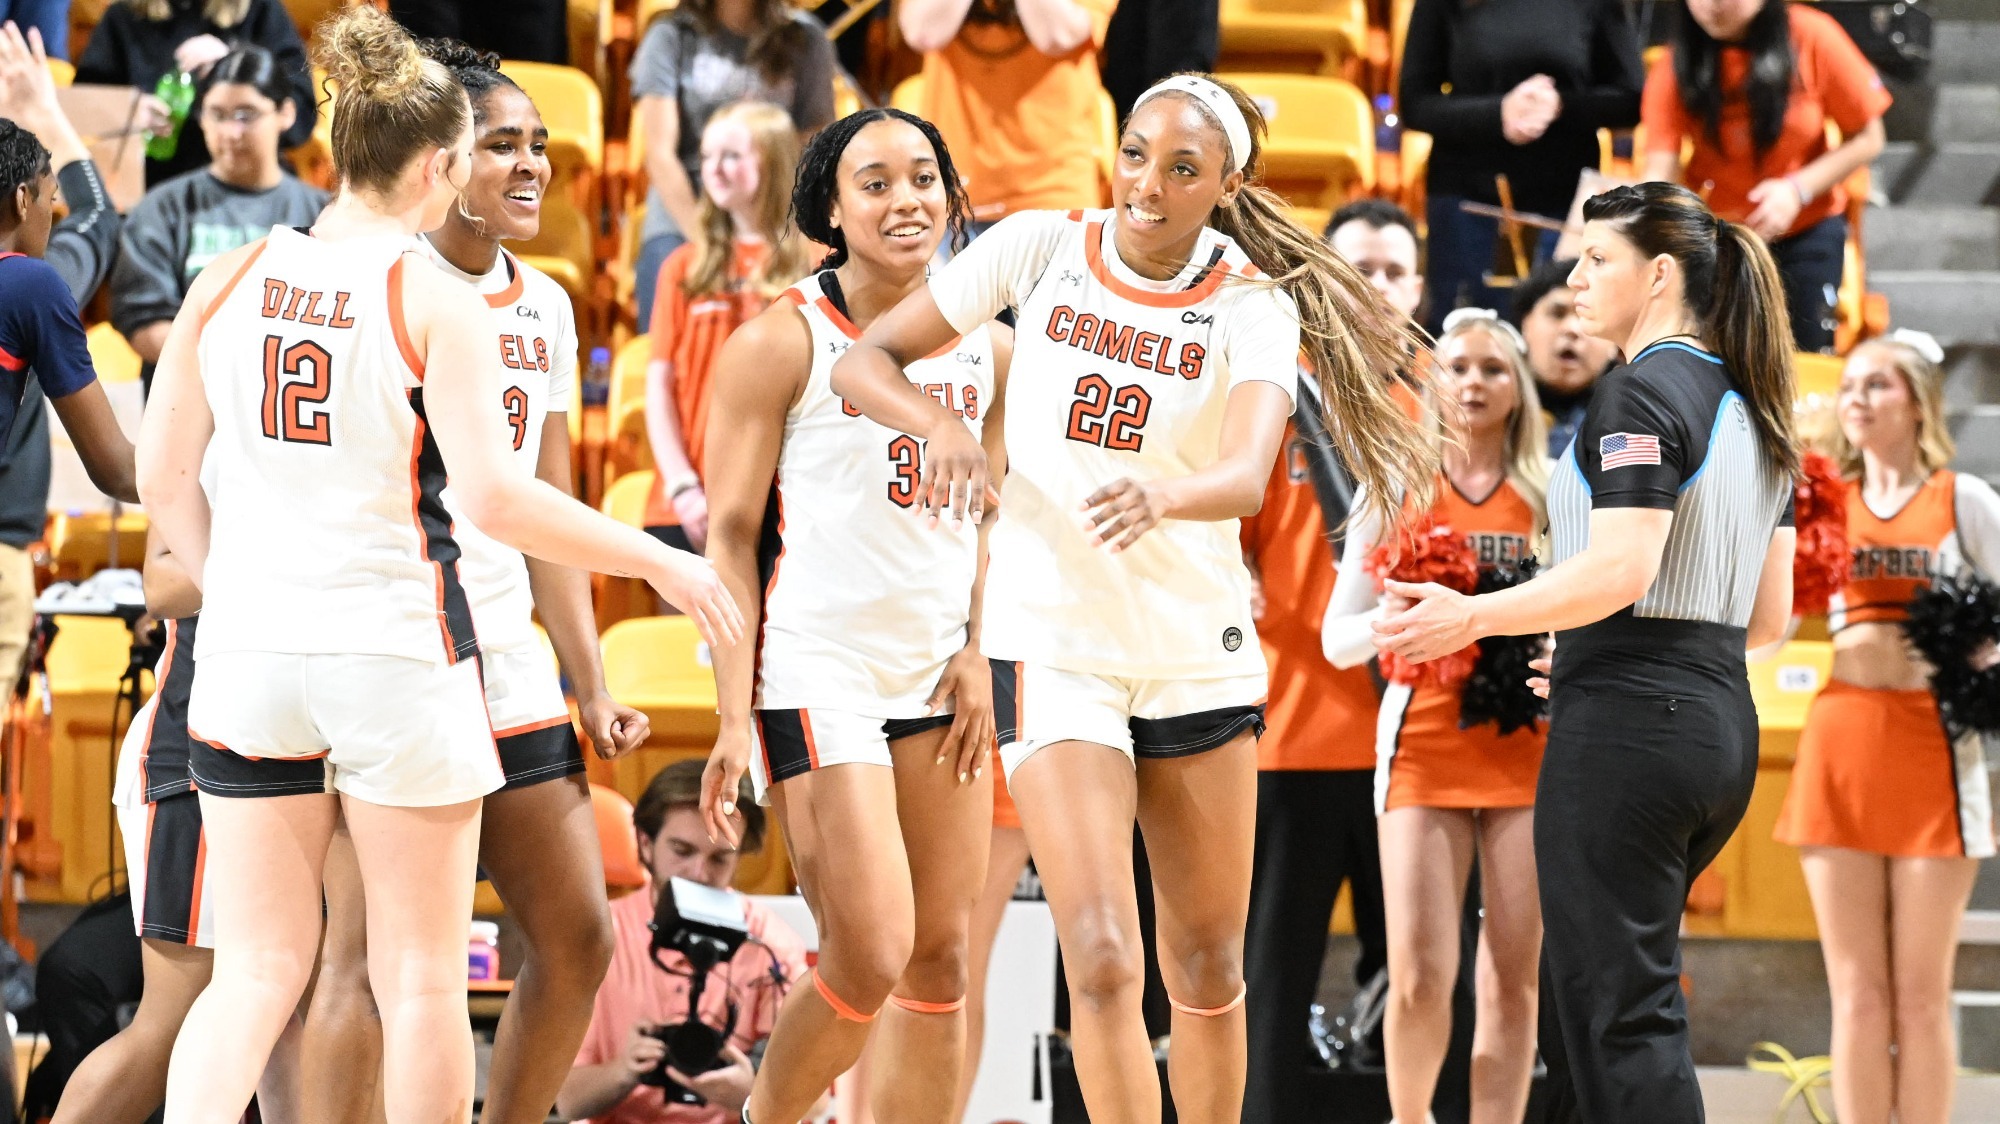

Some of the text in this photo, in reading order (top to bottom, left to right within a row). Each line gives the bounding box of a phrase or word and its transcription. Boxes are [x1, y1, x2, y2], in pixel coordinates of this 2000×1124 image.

[262, 277, 355, 329] DILL
[1181, 310, 1215, 328] CAA
[1045, 305, 1207, 380] CAMELS
[260, 334, 333, 446] 12
[1065, 373, 1153, 453] 22
